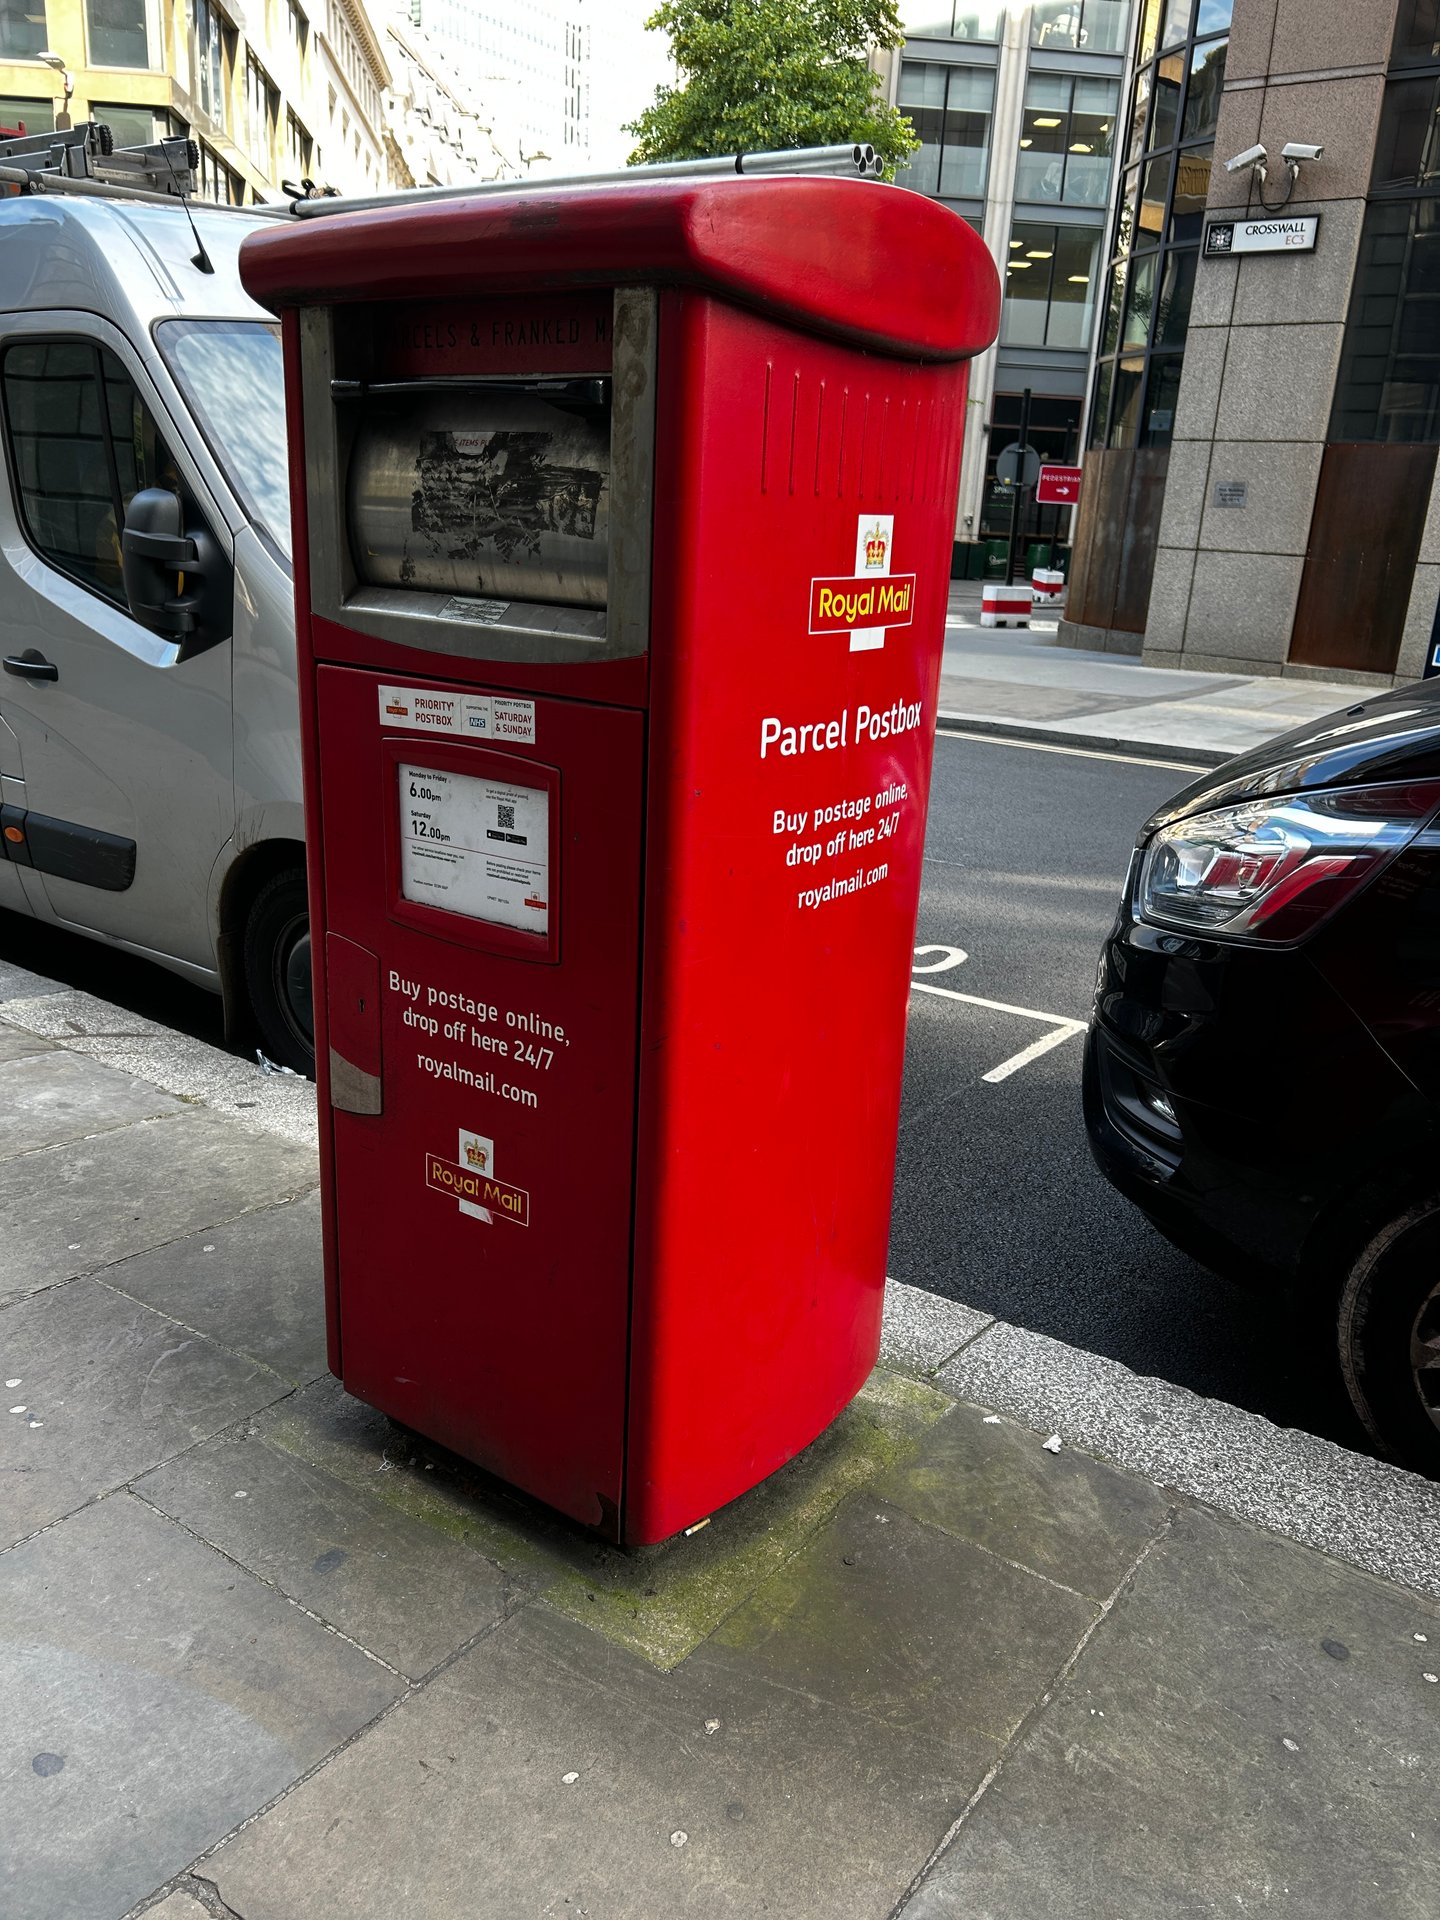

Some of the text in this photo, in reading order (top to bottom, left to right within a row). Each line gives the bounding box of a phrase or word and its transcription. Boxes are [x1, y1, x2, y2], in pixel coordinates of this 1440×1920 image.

[1246, 223, 1305, 235] CROSSWALL
[1286, 235, 1304, 245] EC3
[470, 322, 481, 347] &
[492, 318, 580, 345] FRANKED
[595, 316, 614, 343] M
[459, 439, 479, 447] ITEMS
[818, 583, 910, 624] Royal Mail
[415, 712, 452, 726] POSTBOX
[470, 718, 485, 727] NHS
[494, 711, 532, 724] SATURDAY
[495, 723, 532, 736] & SUNDAY
[760, 698, 922, 759] Parcel Postbox
[409, 771, 426, 780] Monday
[433, 775, 447, 783] Friday
[410, 782, 442, 802] 6.00pm
[411, 810, 431, 819] Saturday
[772, 782, 908, 835] Buy postage online,
[412, 820, 450, 841] 12.00pm
[785, 813, 900, 867] drop off here 24/7
[797, 861, 888, 909] royalmail.com
[389, 970, 570, 1047] Buy postage online,
[403, 1007, 554, 1070] drop off here 24/7
[417, 1053, 538, 1108] royalmail.com
[432, 1161, 522, 1214] Royal Mail
